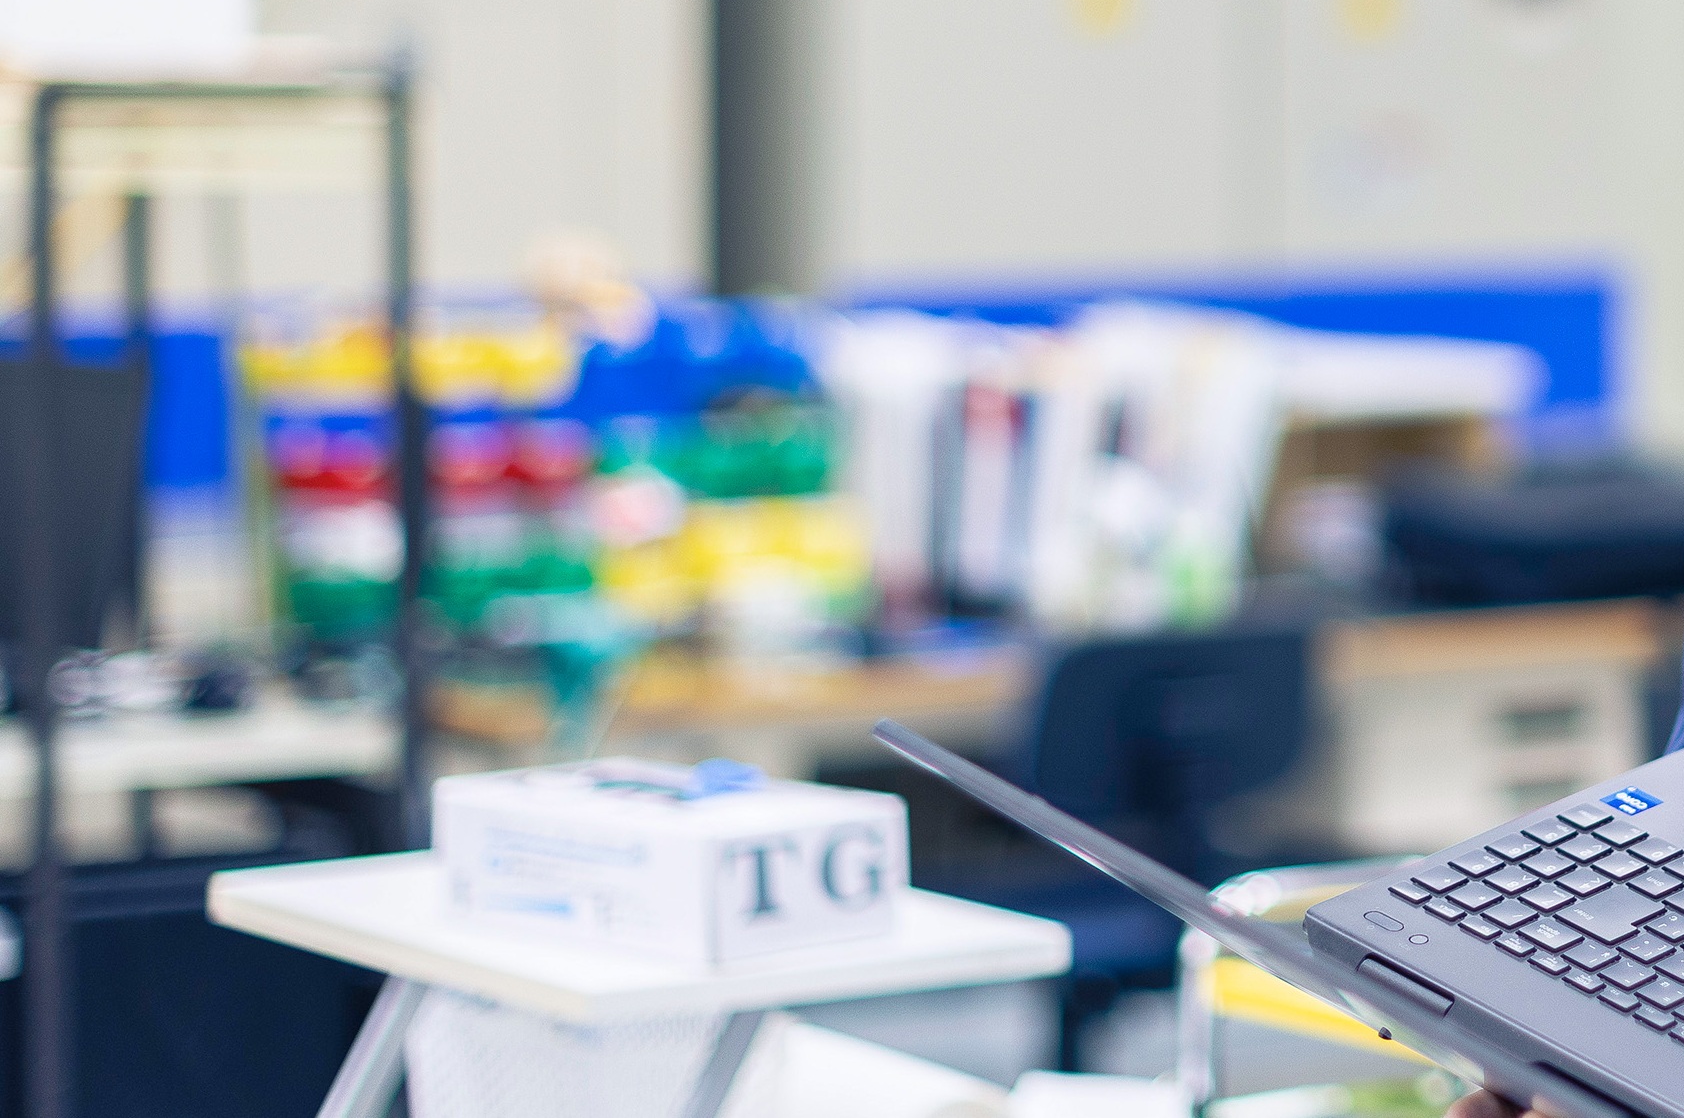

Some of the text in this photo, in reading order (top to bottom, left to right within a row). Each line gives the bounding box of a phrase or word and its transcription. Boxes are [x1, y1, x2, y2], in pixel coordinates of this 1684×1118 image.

[1650, 850, 1664, 858] 0
[1471, 863, 1485, 871] 9
[1542, 864, 1557, 872] 5
[1506, 880, 1520, 888] 8
[1645, 875, 1665, 887] Shift
[1573, 908, 1595, 921] Enter
[1536, 927, 1555, 939] Back
[1539, 923, 1561, 936] space
